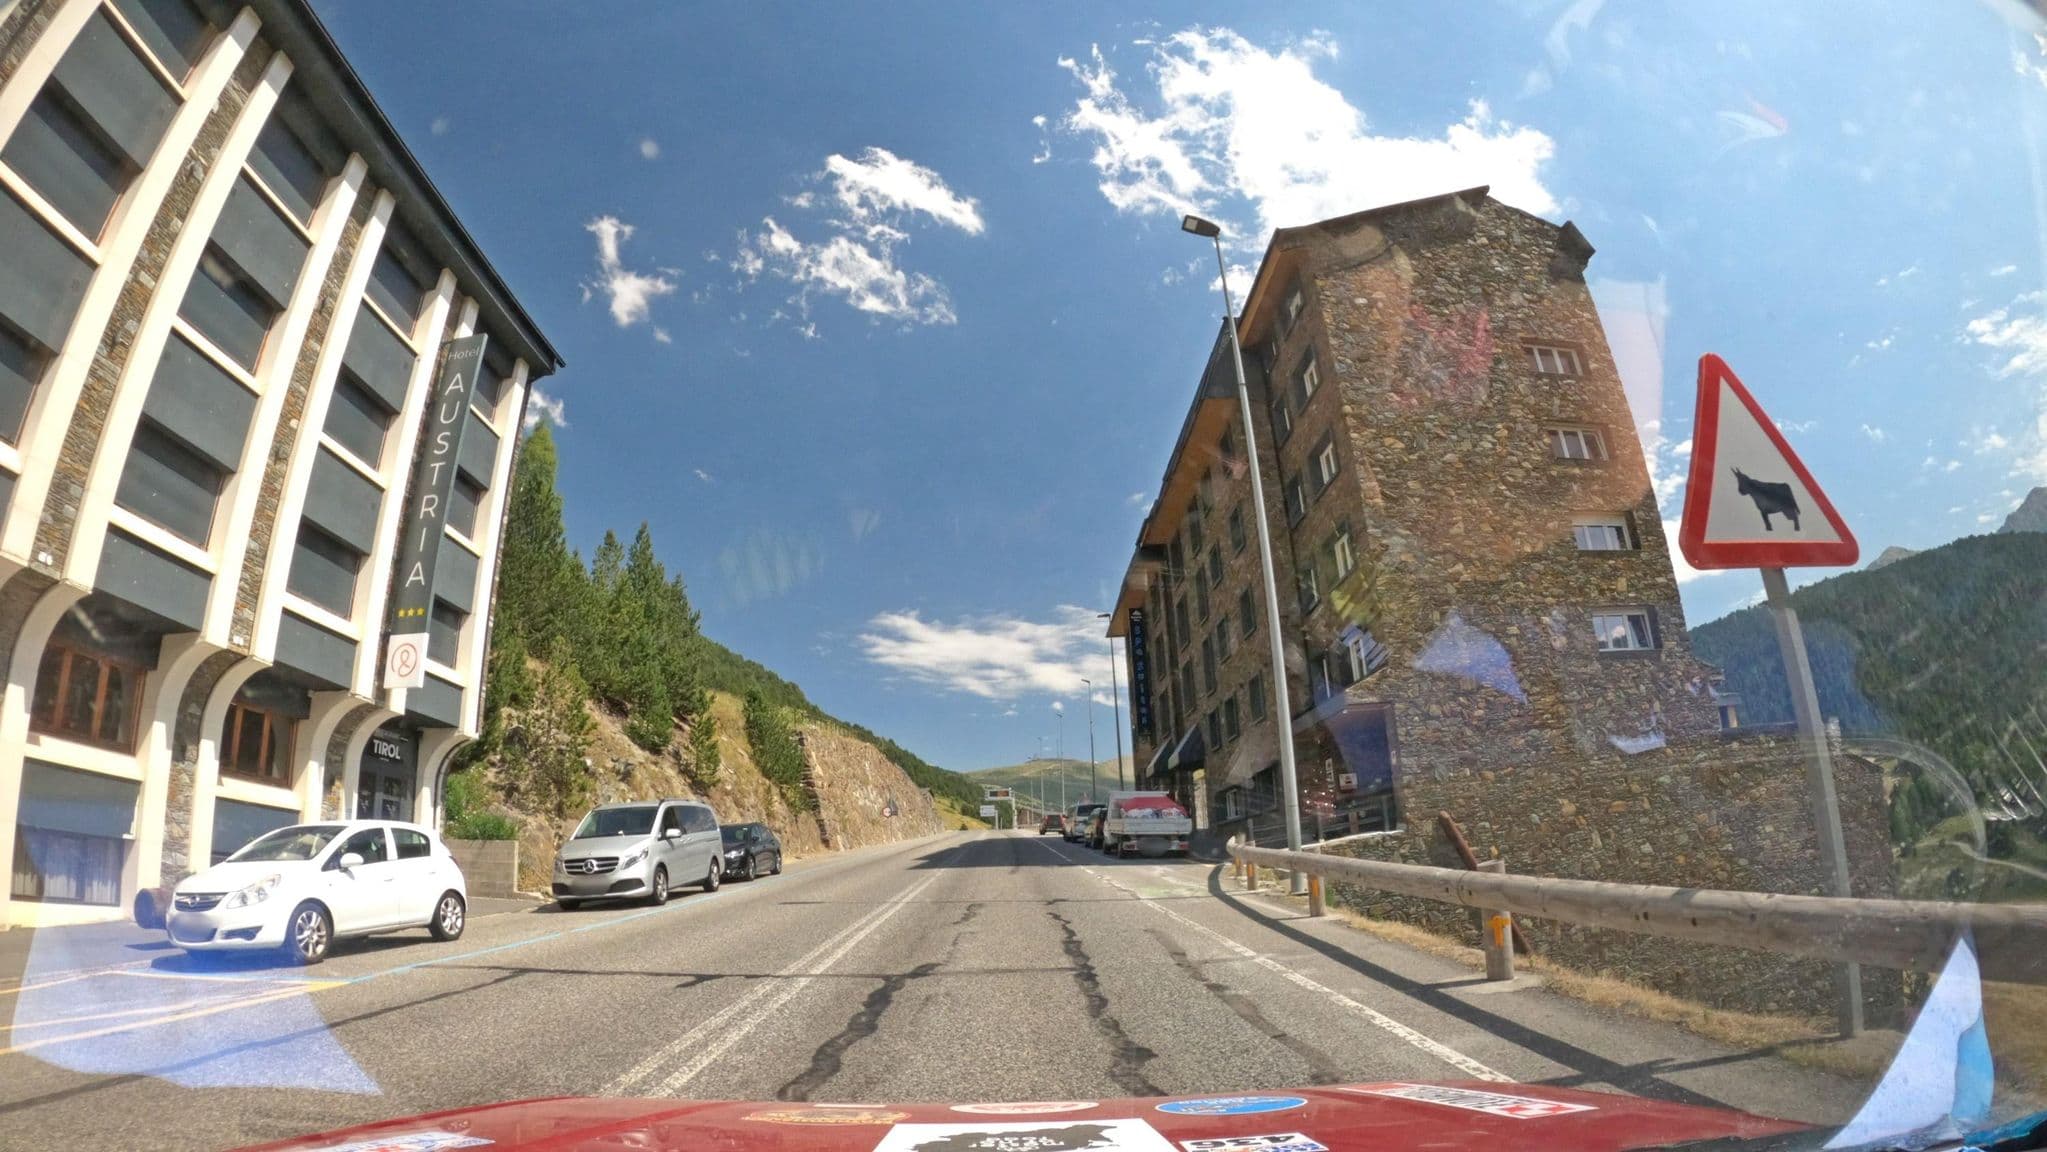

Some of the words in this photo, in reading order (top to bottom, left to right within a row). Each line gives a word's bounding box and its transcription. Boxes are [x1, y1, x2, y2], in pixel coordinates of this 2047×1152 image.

[448, 346, 479, 362] Hotel
[405, 372, 465, 588] AUSTRIA
[372, 739, 401, 760] TIROL
